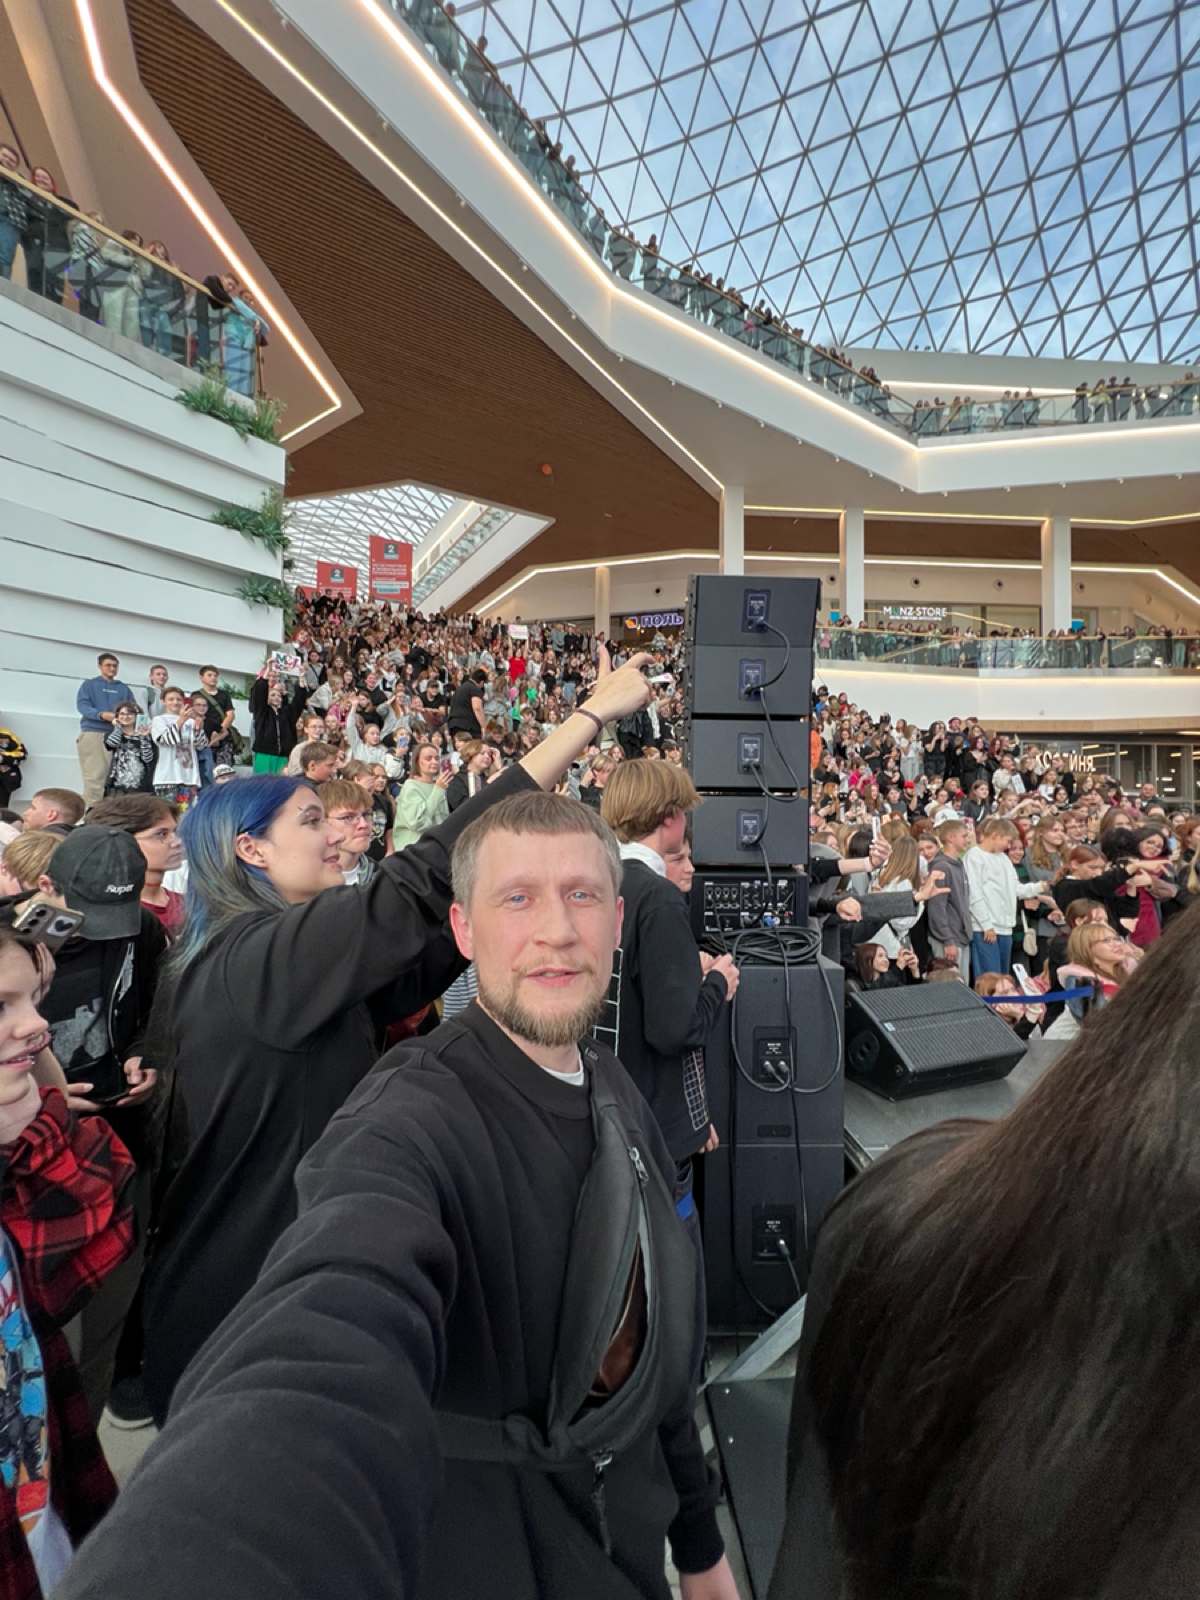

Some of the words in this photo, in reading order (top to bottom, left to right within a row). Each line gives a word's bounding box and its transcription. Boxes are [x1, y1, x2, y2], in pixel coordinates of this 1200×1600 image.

[388, 544, 395, 553] 2
[915, 607, 947, 617] STORE
[1035, 750, 1094, 773] КОЙНЯ
